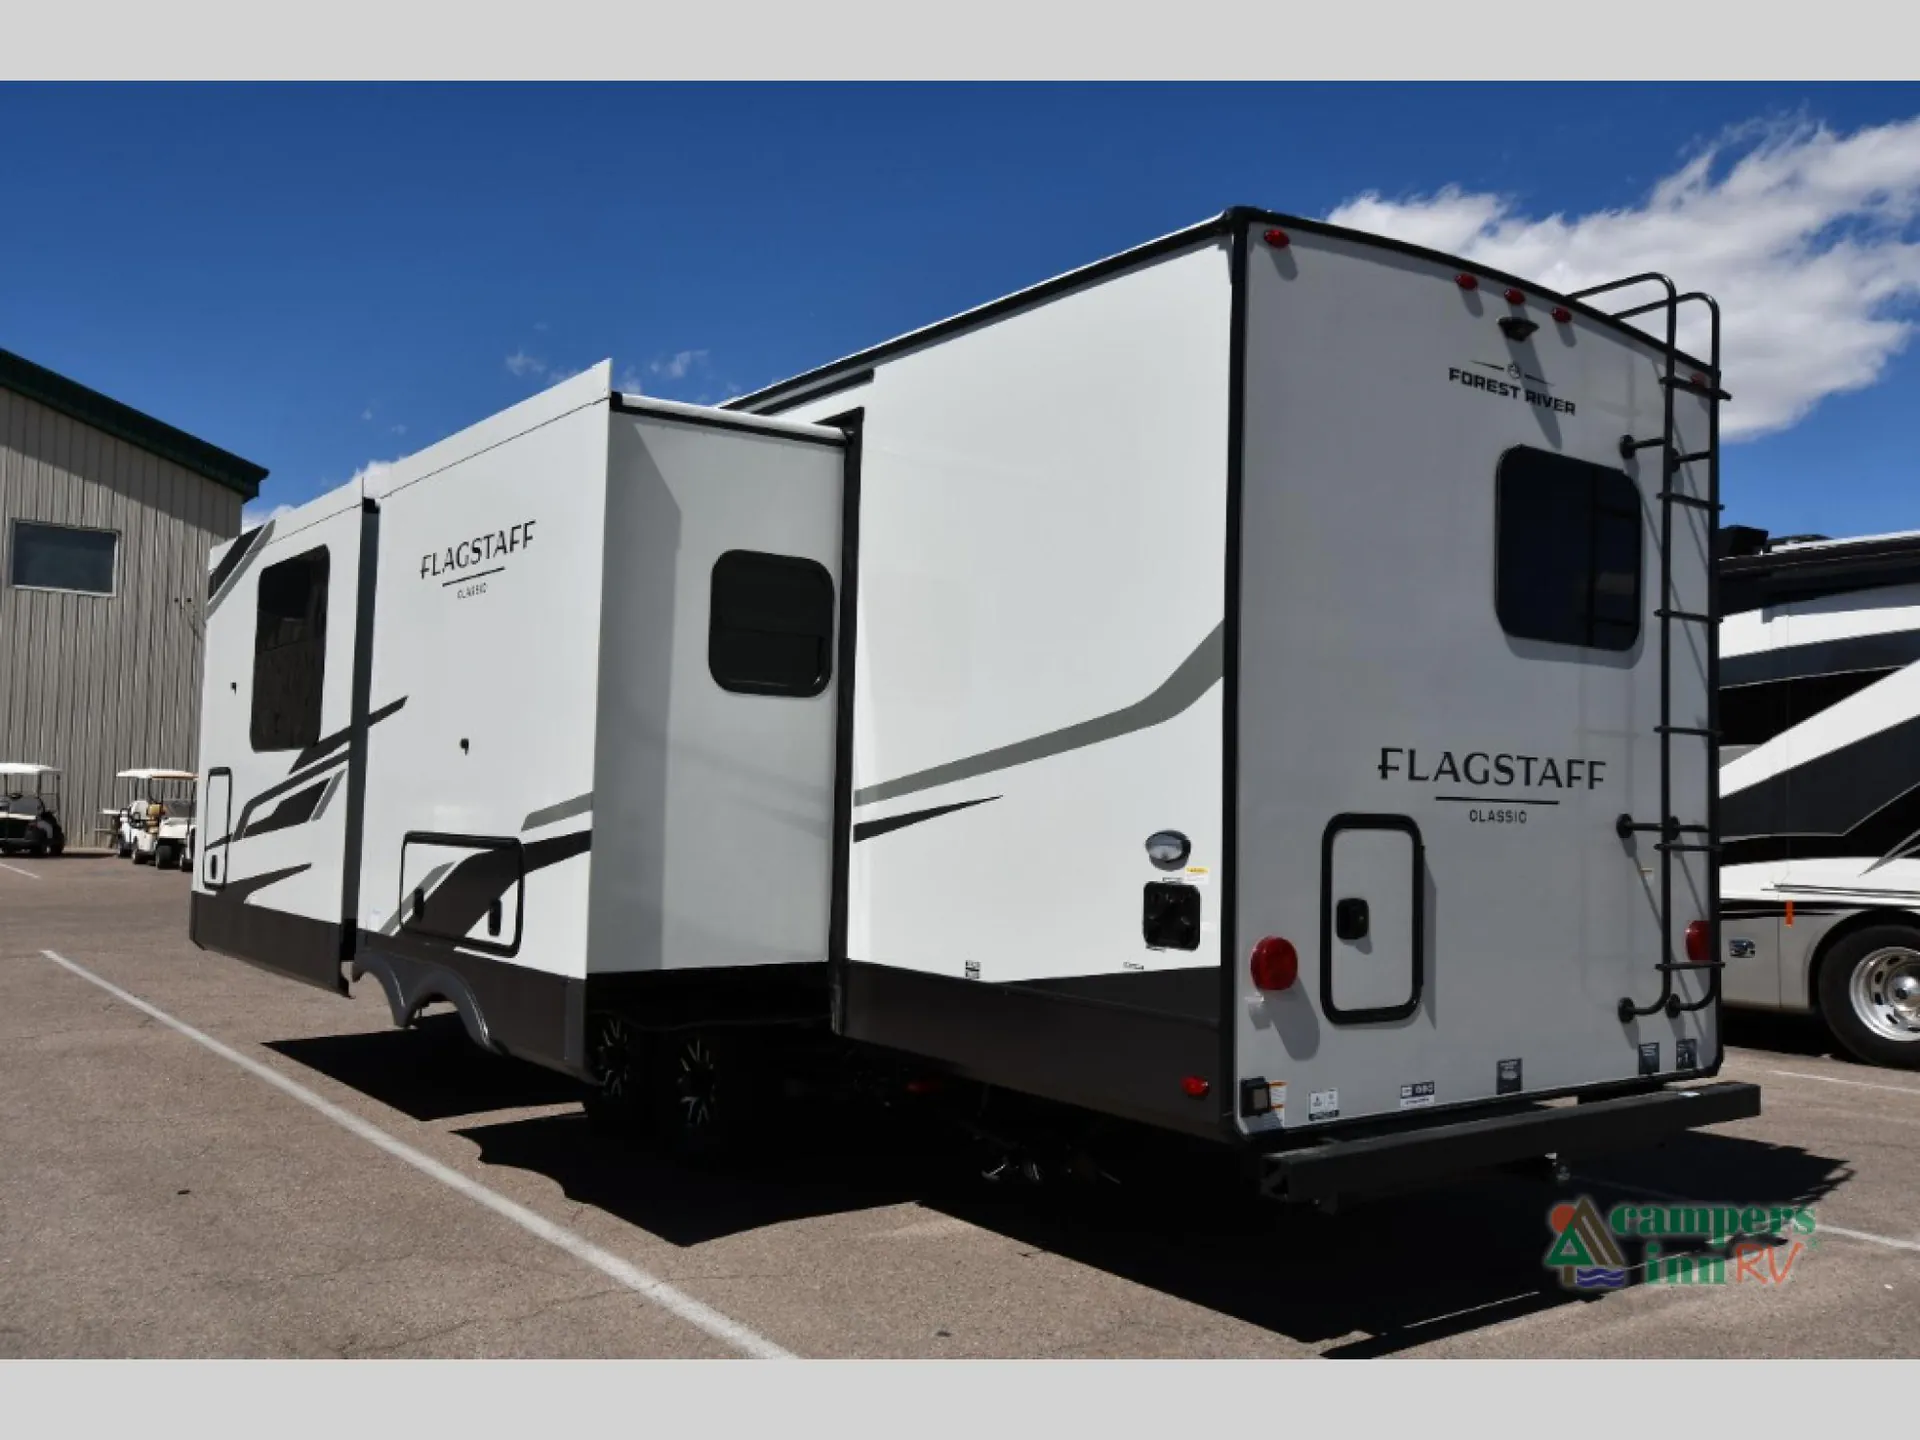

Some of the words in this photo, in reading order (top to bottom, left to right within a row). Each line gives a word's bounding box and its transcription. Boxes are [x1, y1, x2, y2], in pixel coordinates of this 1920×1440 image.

[1448, 366, 1521, 400] FOREST
[1524, 389, 1576, 416] RIVER
[419, 519, 537, 580] FLAGSTAFF
[1377, 747, 1607, 790] FLAGSTAFF
[1469, 809, 1527, 824] CLASSIC
